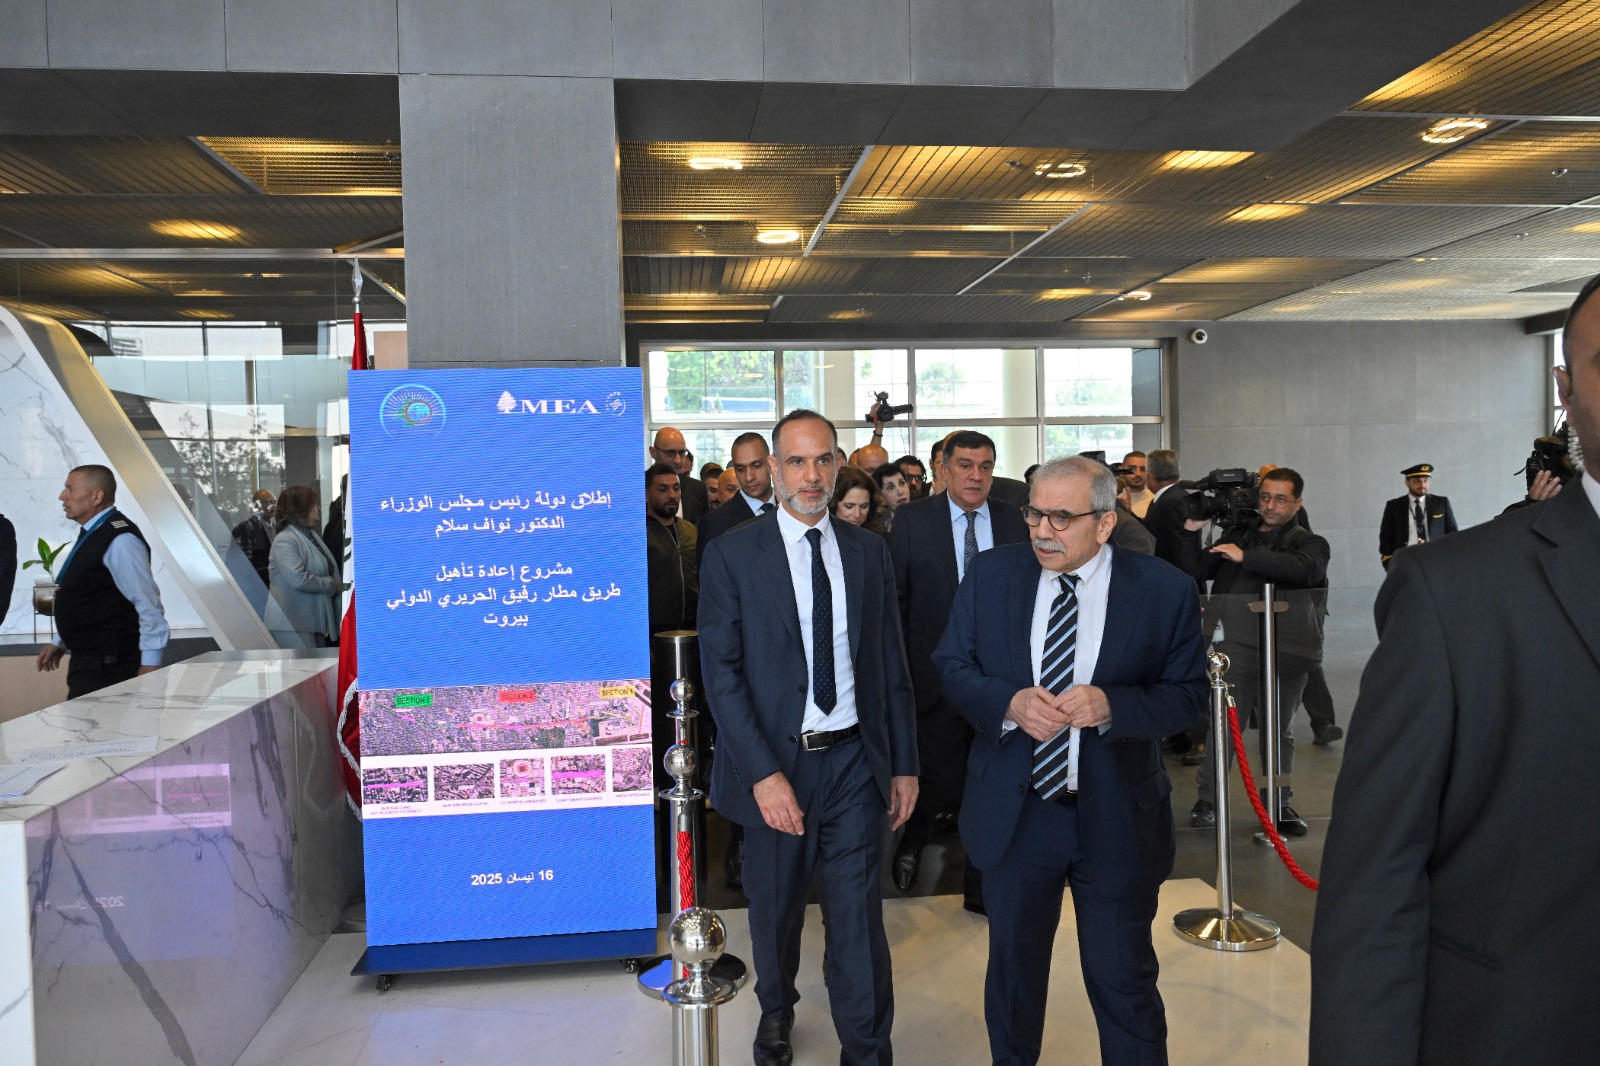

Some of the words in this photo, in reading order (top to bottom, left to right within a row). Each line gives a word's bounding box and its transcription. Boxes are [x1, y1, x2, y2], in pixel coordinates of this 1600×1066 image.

[519, 399, 602, 414] MEA
[380, 494, 433, 513] الوزراء
[438, 493, 485, 512] مجلس
[489, 497, 530, 511] رئيس
[534, 490, 566, 509] دولة
[571, 490, 611, 509] إطلاق
[435, 518, 469, 537] سلام
[473, 517, 511, 534] نواف
[514, 516, 565, 534] الدكتور
[435, 561, 474, 582] تأهيل
[478, 564, 515, 581] إعادة
[519, 562, 573, 583] مشروع
[386, 588, 432, 610] الدولي
[437, 587, 497, 609] الحريري
[502, 584, 538, 605] رفيق
[542, 584, 578, 602] مطار
[581, 583, 621, 602] طريق
[483, 613, 529, 628] بيروت
[470, 872, 503, 886] 2025
[506, 872, 535, 884] نيسان
[538, 869, 554, 882] 16
